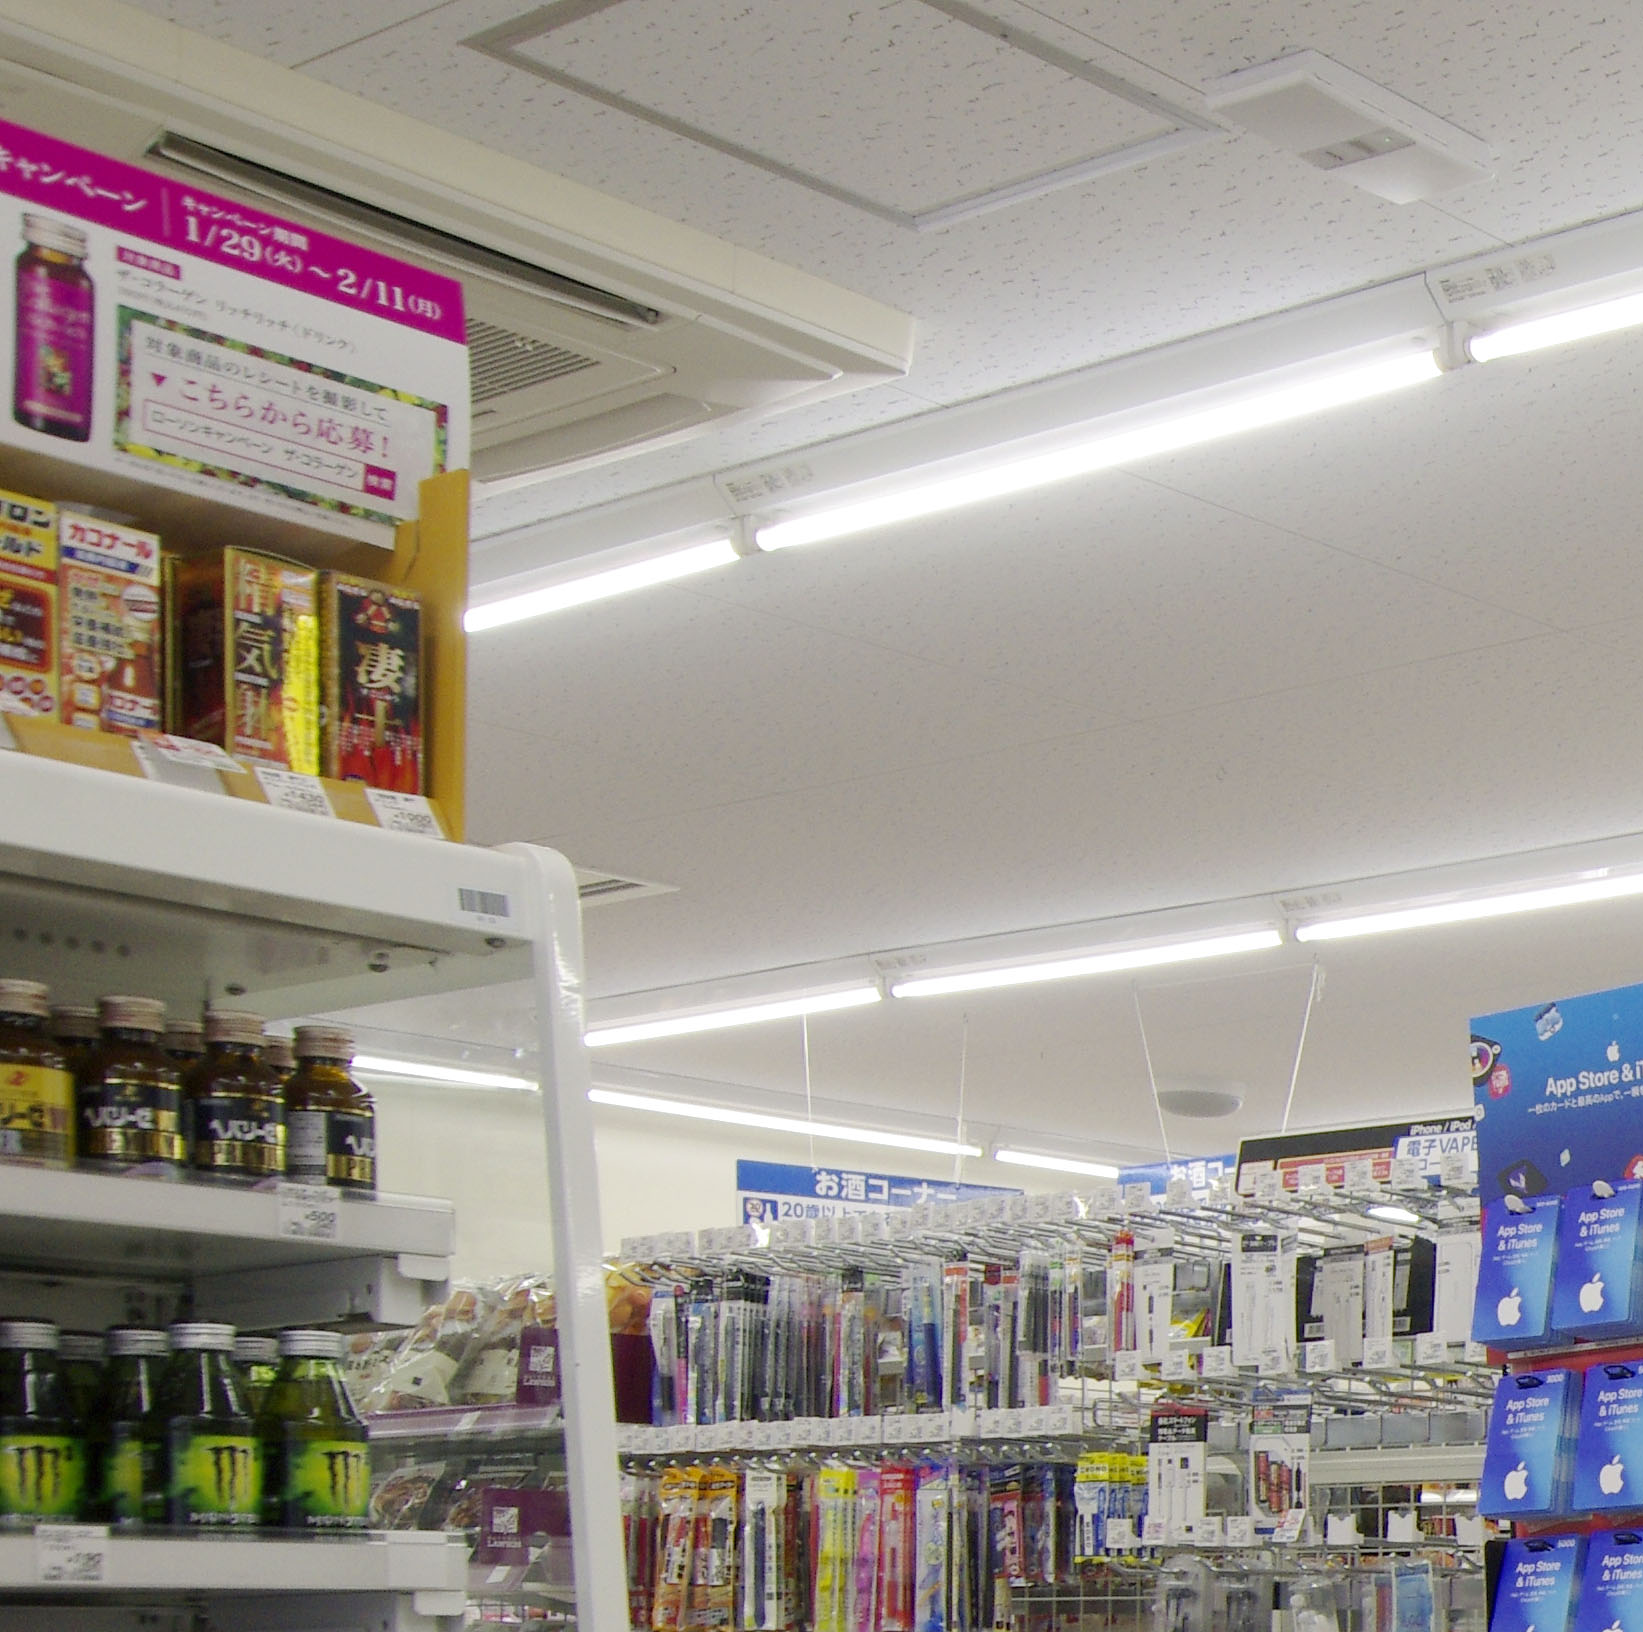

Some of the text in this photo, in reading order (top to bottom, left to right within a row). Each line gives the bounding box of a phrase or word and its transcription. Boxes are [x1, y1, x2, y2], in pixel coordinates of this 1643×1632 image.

[70, 523, 153, 560] カコナール
[1546, 1075, 1577, 1098] App
[1579, 1066, 1620, 1090] Store
[1621, 1065, 1635, 1082] &
[1409, 1118, 1474, 1137] iPhone iPod
[814, 1171, 958, 1202] お酒コーナー
[1578, 1206, 1626, 1224] App Store
[1497, 1222, 1544, 1238] App Store
[1579, 1222, 1621, 1238] & iTunes
[1498, 1237, 1538, 1251] & iTunes
[1505, 1394, 1550, 1411] App Store
[1597, 1386, 1643, 1403] App Store
[1506, 1408, 1546, 1424] & iTunes
[1598, 1401, 1639, 1416] & iTunes
[1515, 1558, 1561, 1575] App Store
[1602, 1555, 1622, 1570] App
[1516, 1573, 1556, 1588] & iTunes
[1602, 1567, 1643, 1582] & iTunes
